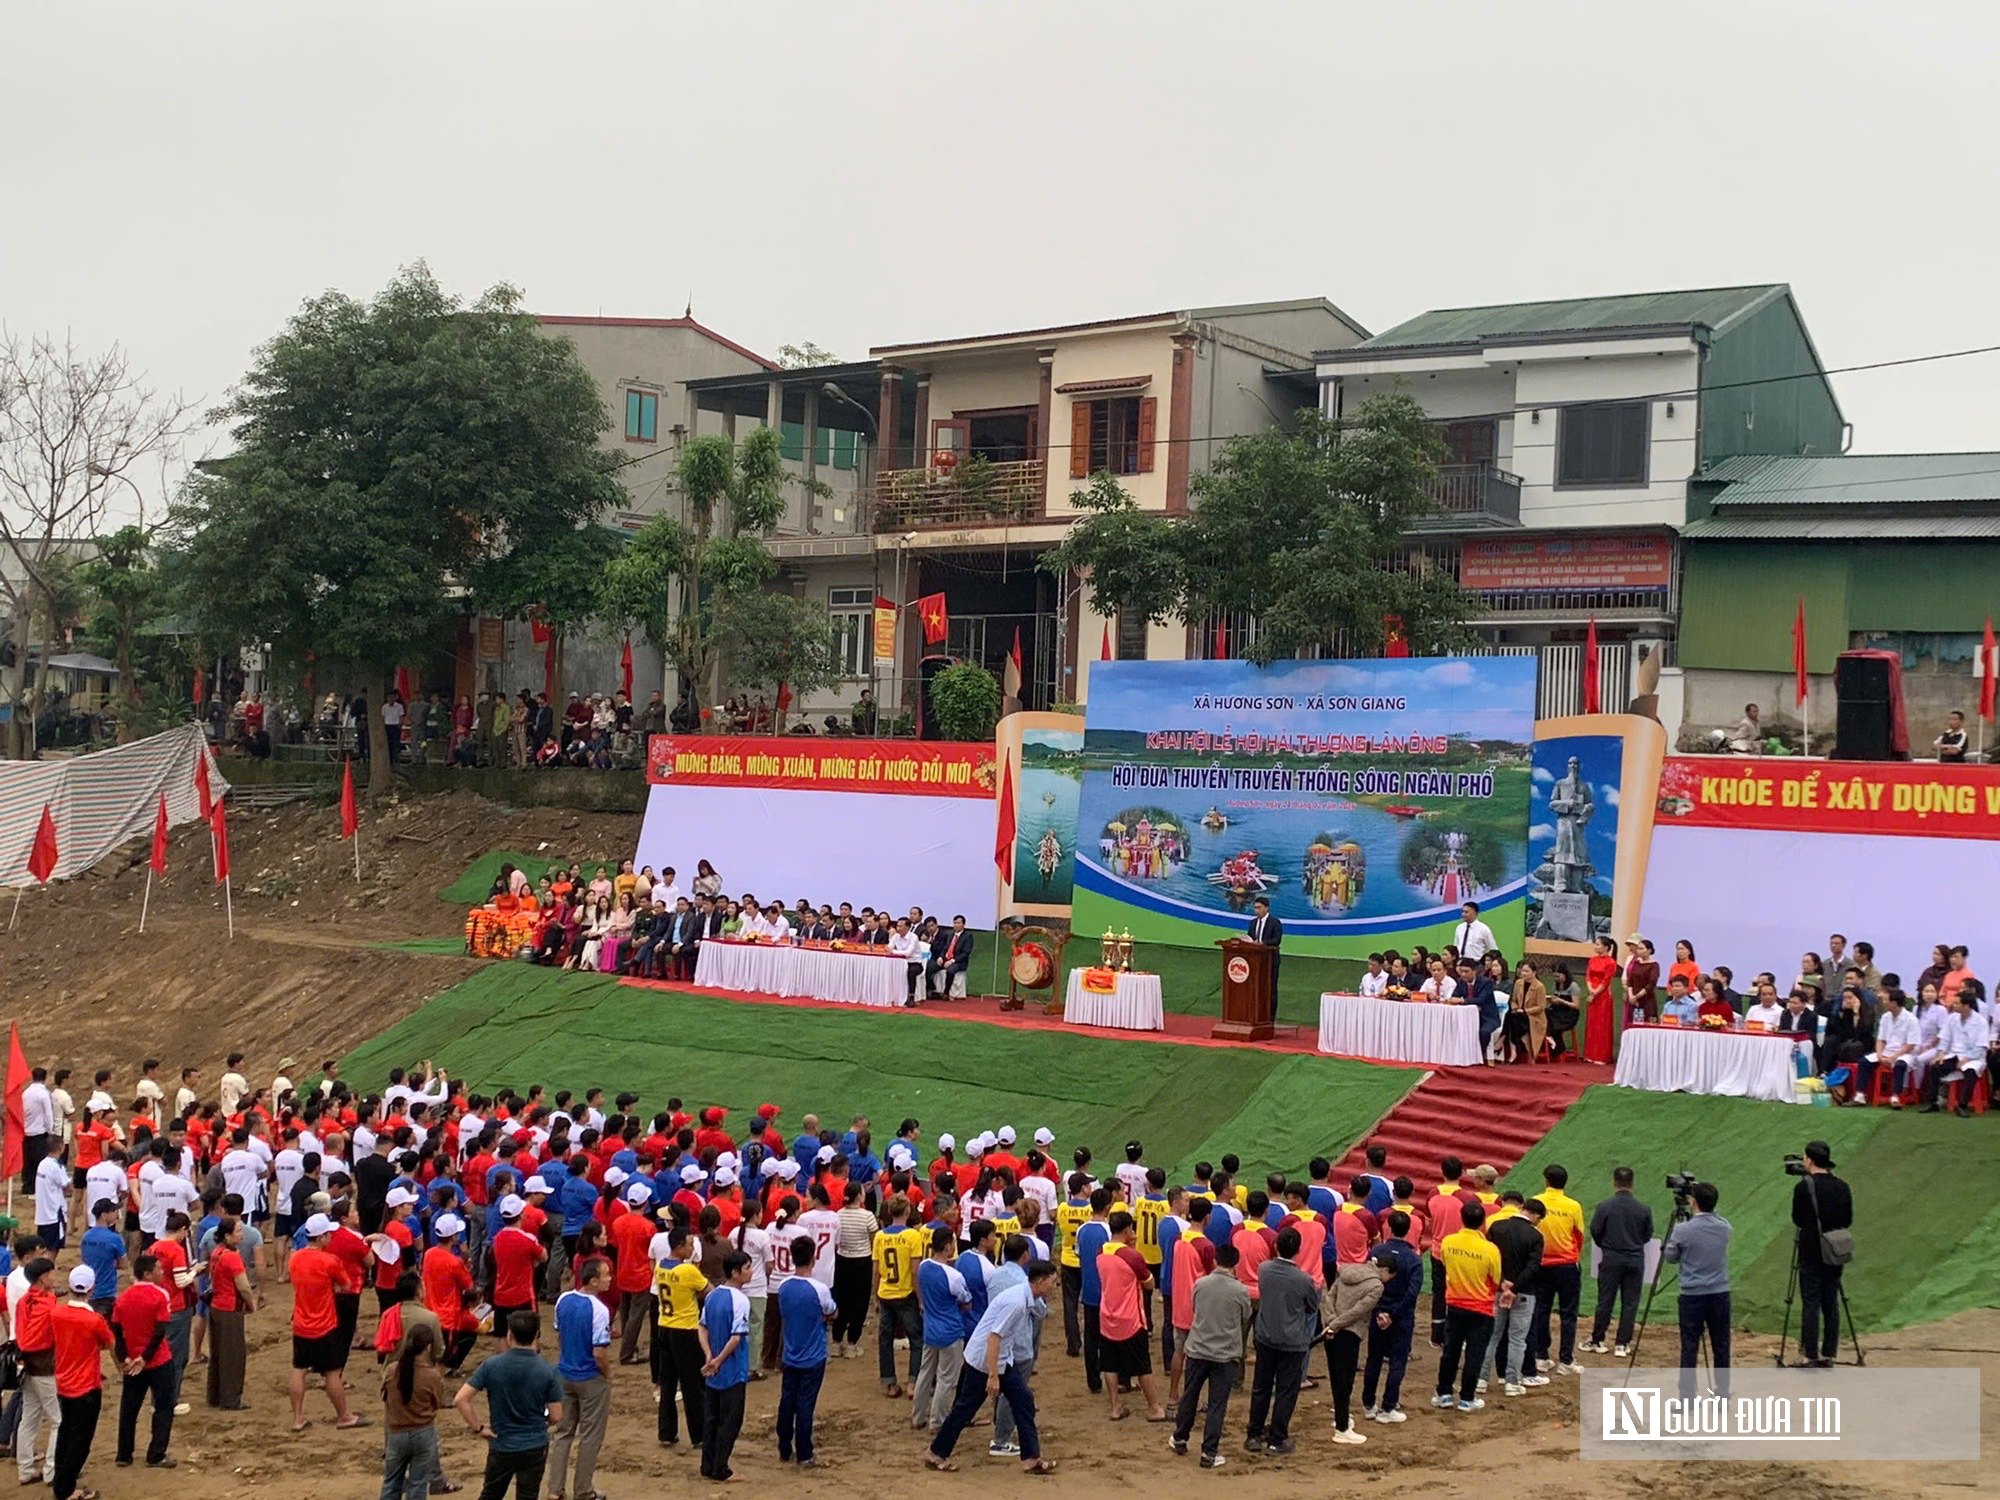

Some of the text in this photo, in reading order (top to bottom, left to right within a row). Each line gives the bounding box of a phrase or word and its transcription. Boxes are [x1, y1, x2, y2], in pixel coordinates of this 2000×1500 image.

[1193, 694, 1211, 710] XÃ
[1214, 696, 1262, 710] HƯƠNG
[1266, 696, 1294, 710] SƠN
[1307, 694, 1325, 710] XÃ
[1328, 696, 1357, 710] SƠN
[1361, 697, 1406, 710] GIANG
[1146, 732, 1182, 750] KHAI
[1184, 728, 1210, 755] HỘI
[1213, 725, 1233, 751] LỄ
[1236, 728, 1263, 755] HỘI
[1266, 728, 1293, 751] HẢI
[1296, 733, 1367, 756] THƯỢNG
[1408, 730, 1448, 754] ÔNG
[675, 747, 972, 784] MỪNG ĐẢNG, MỪNG XUÂN, MỪNG ĐẤT NƯỚC ĐỔI MỚI
[1112, 762, 1136, 791] HỘI
[1173, 761, 1228, 789] THUYỀN
[1234, 762, 1292, 791] TRUYỀN
[1297, 763, 1349, 793] THỐNG
[1354, 766, 1399, 794] SÔNG
[1405, 768, 1452, 796] NGÀN
[1458, 766, 1496, 797] PHỐ
[1701, 767, 1773, 806] KHỎE
[1782, 770, 1821, 808] ĐỂ
[1826, 776, 1884, 811] XÂY
[1892, 781, 1976, 818] DỰNG
[1141, 1211, 1157, 1246] 11
[815, 1232, 831, 1260] 7
[1447, 1247, 1483, 1261] VIETNAM
[884, 1247, 899, 1284] 9
[659, 1283, 675, 1317] 6
